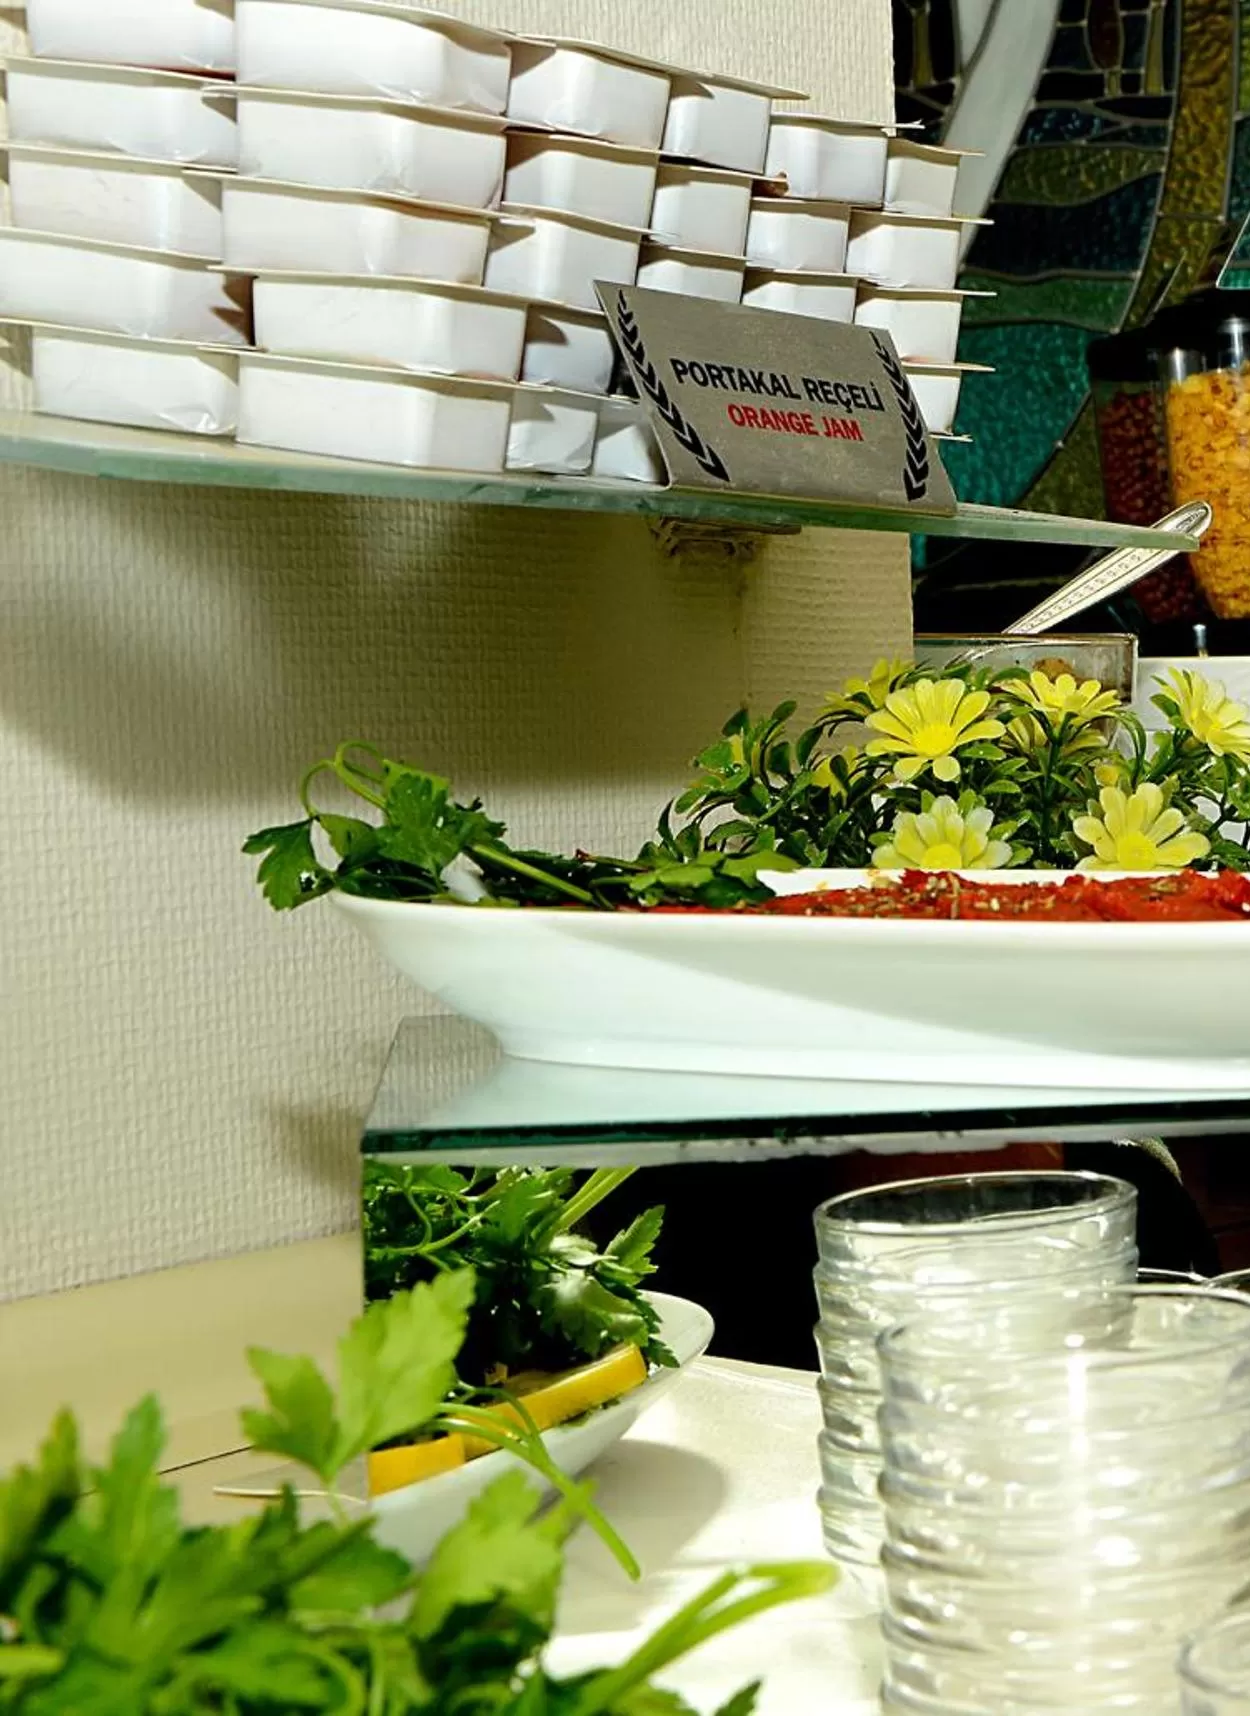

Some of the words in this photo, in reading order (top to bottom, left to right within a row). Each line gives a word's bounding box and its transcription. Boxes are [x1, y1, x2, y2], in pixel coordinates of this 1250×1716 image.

[669, 358, 801, 400] PORTAKAL
[802, 377, 885, 413] REÇELİ
[727, 404, 818, 436] ORANGE
[823, 416, 864, 441] JAM
